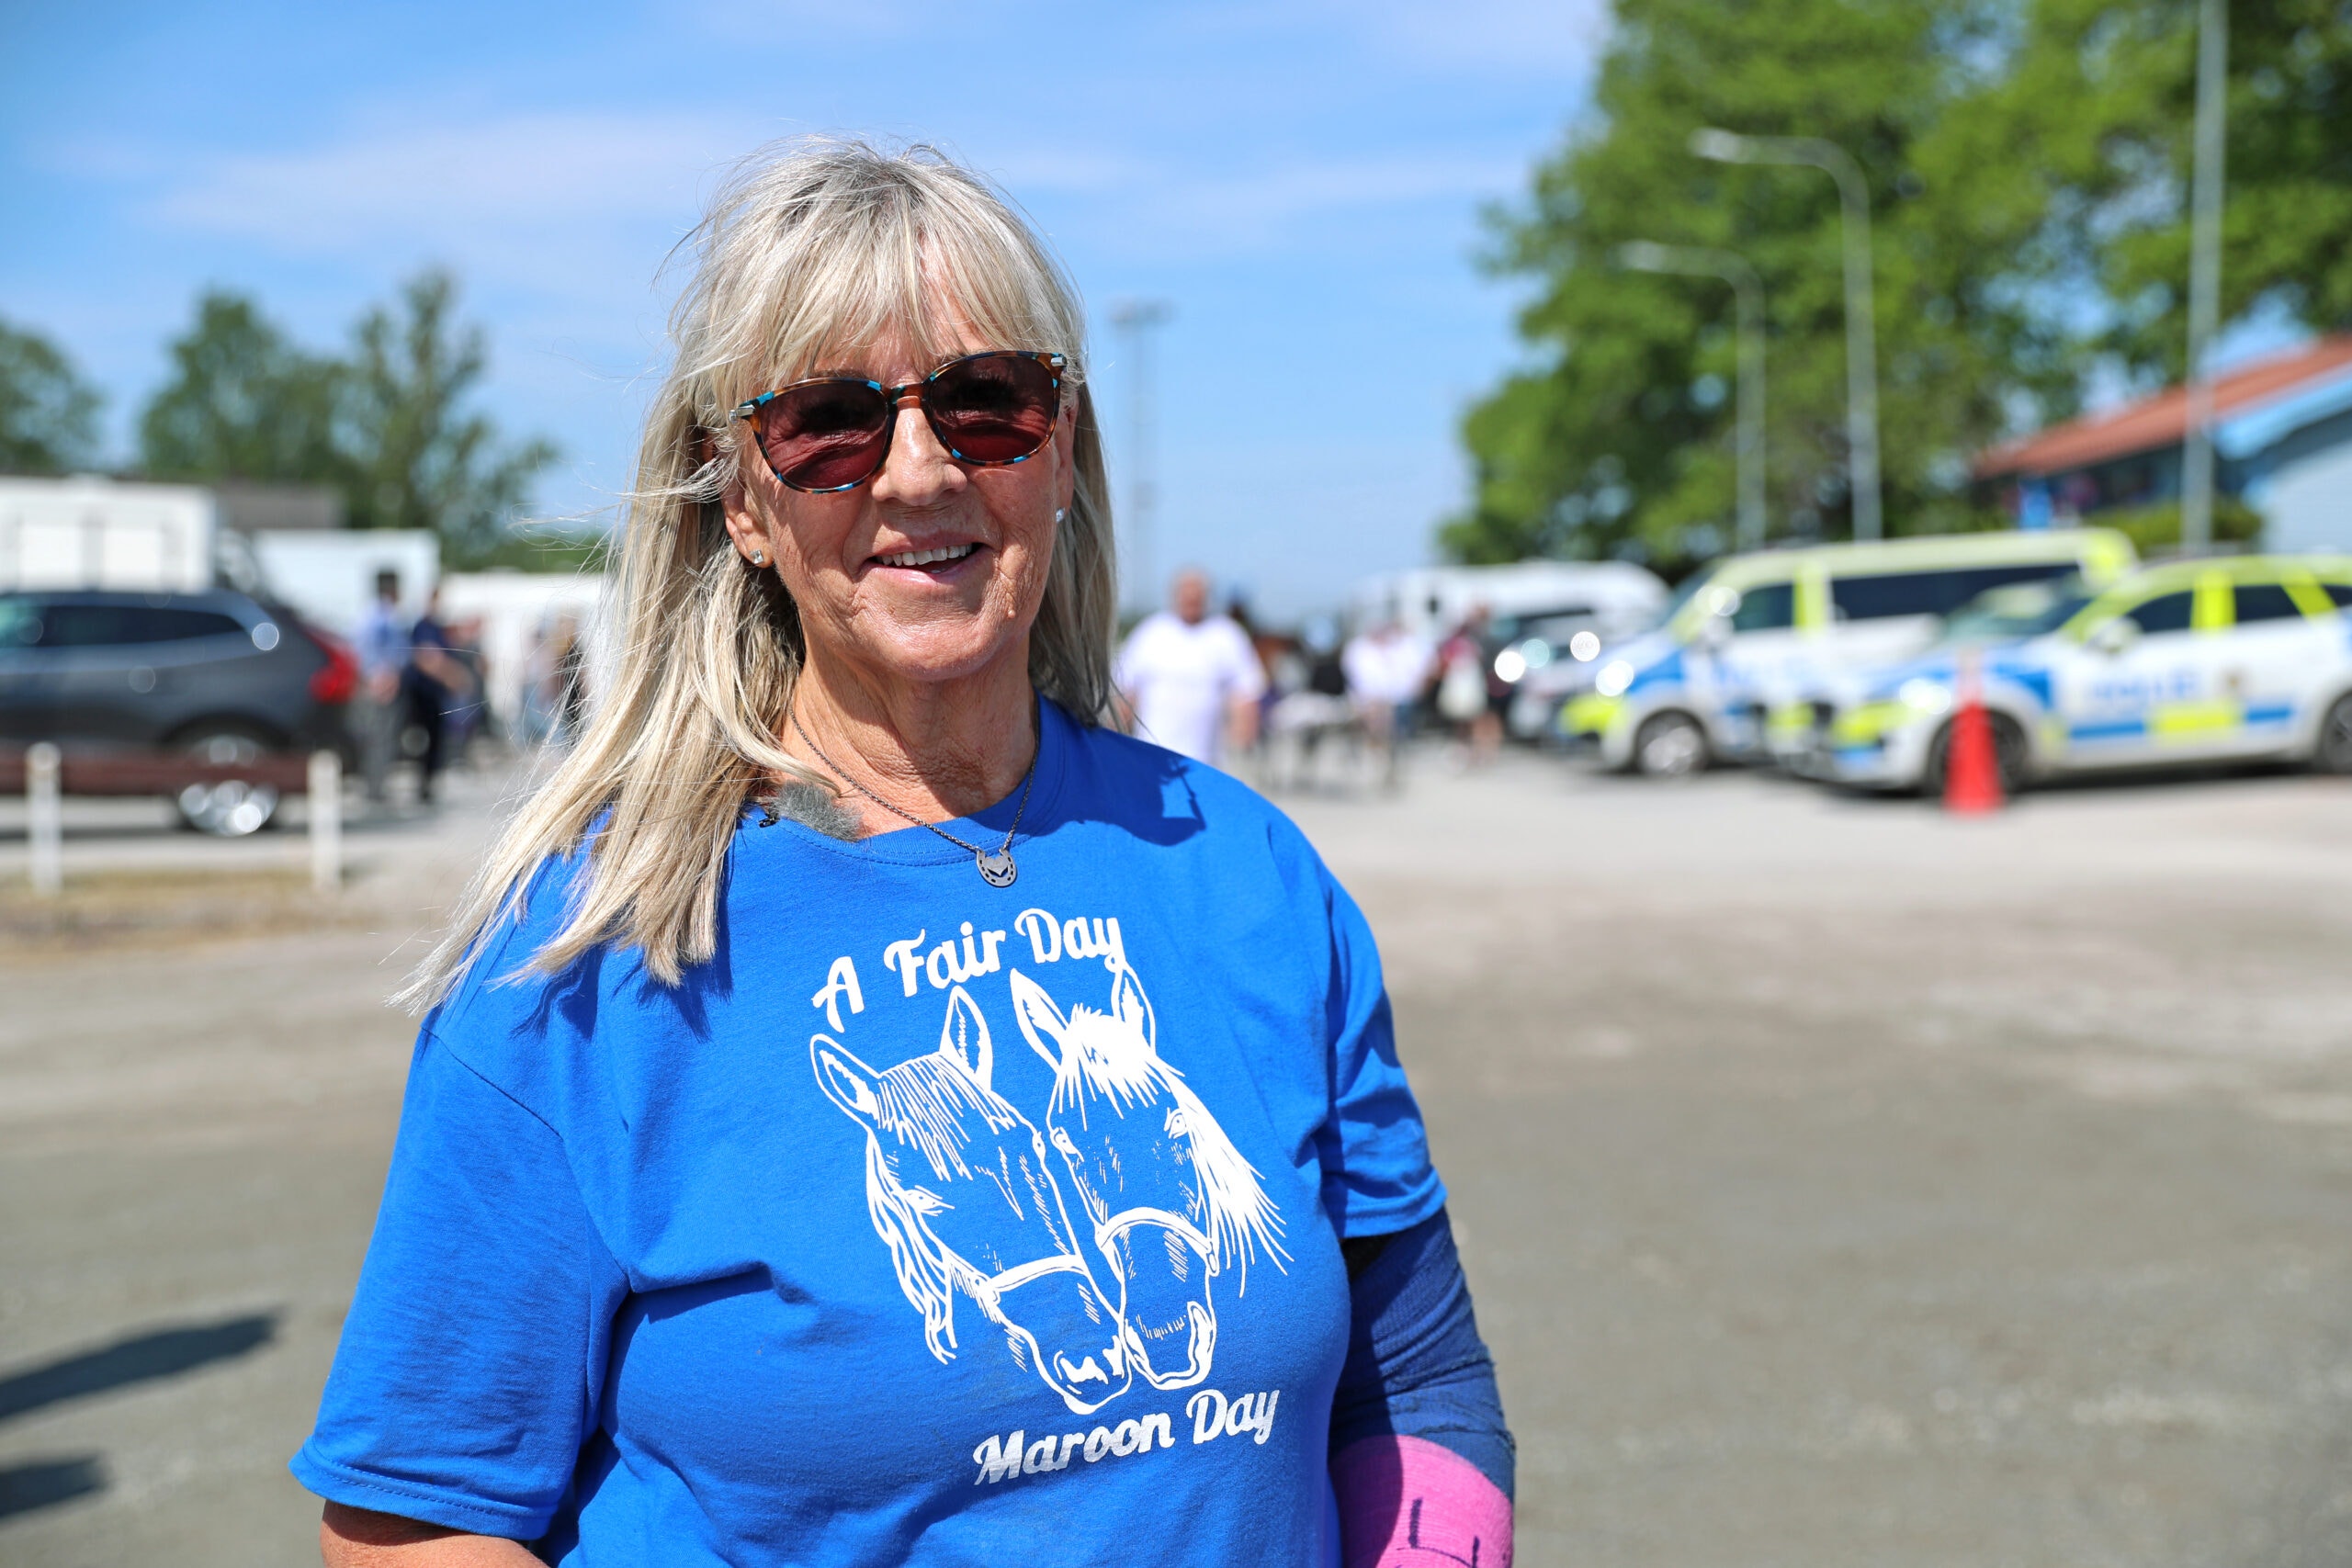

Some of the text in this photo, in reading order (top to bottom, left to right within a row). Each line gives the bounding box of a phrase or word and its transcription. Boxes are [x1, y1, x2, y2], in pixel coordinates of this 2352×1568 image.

[812, 908, 1128, 1032] A Fair Day
[974, 1389, 1280, 1485] Maroon Day
